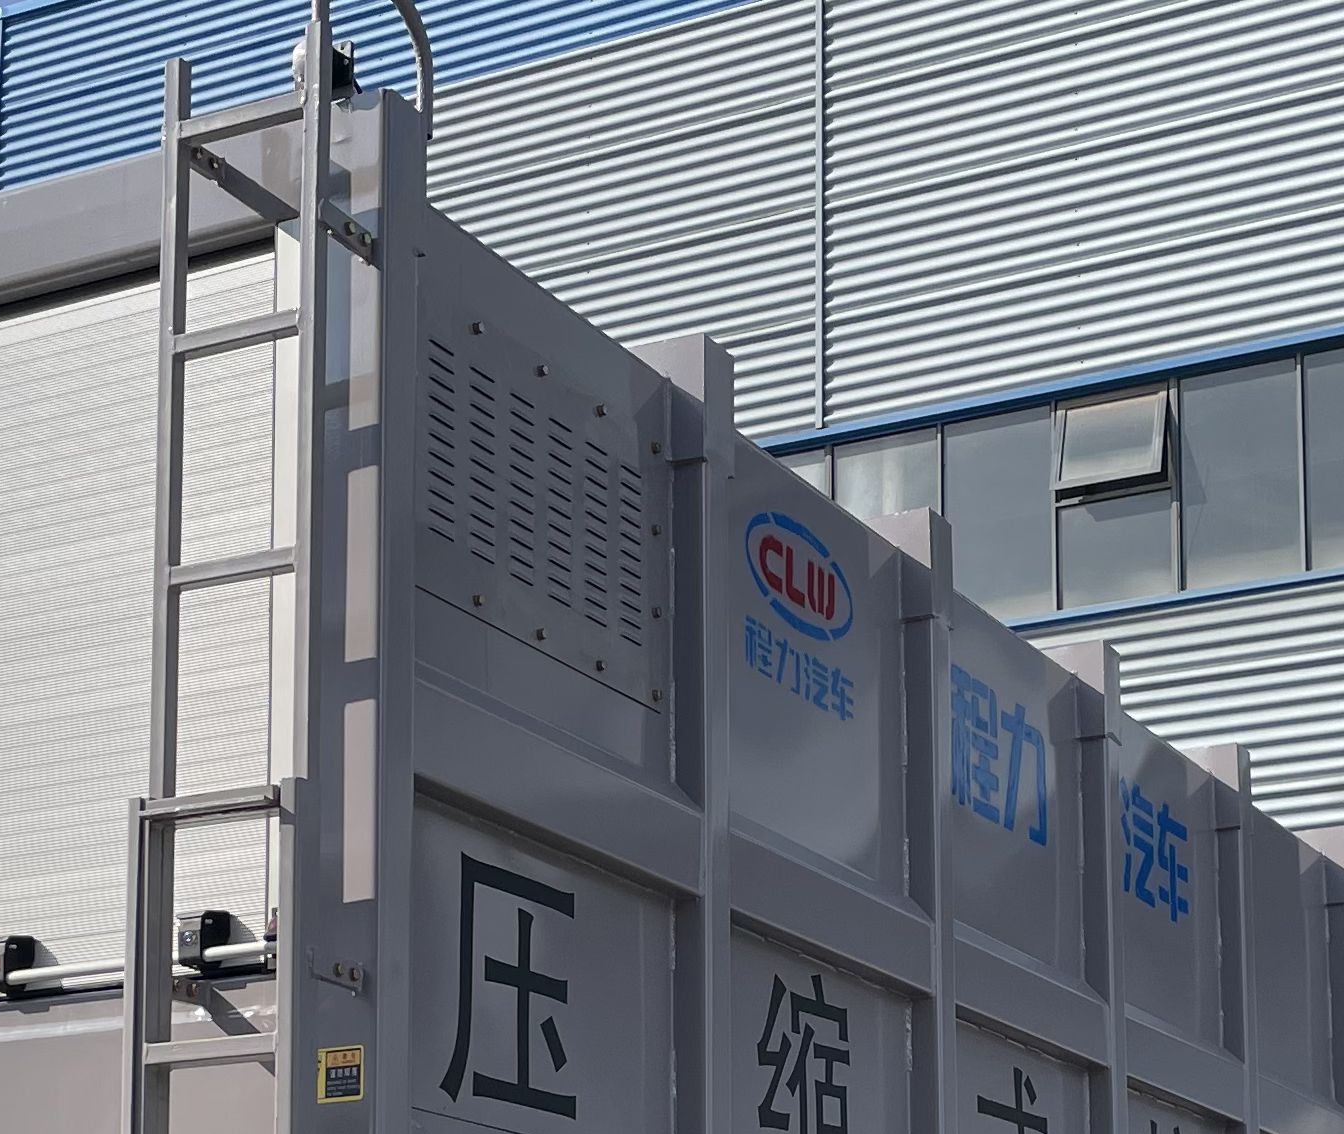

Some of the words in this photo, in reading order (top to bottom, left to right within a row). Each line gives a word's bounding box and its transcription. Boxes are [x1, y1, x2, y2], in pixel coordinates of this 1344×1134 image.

[759, 534, 837, 620] CLW
[745, 617, 855, 721] 程力汽车
